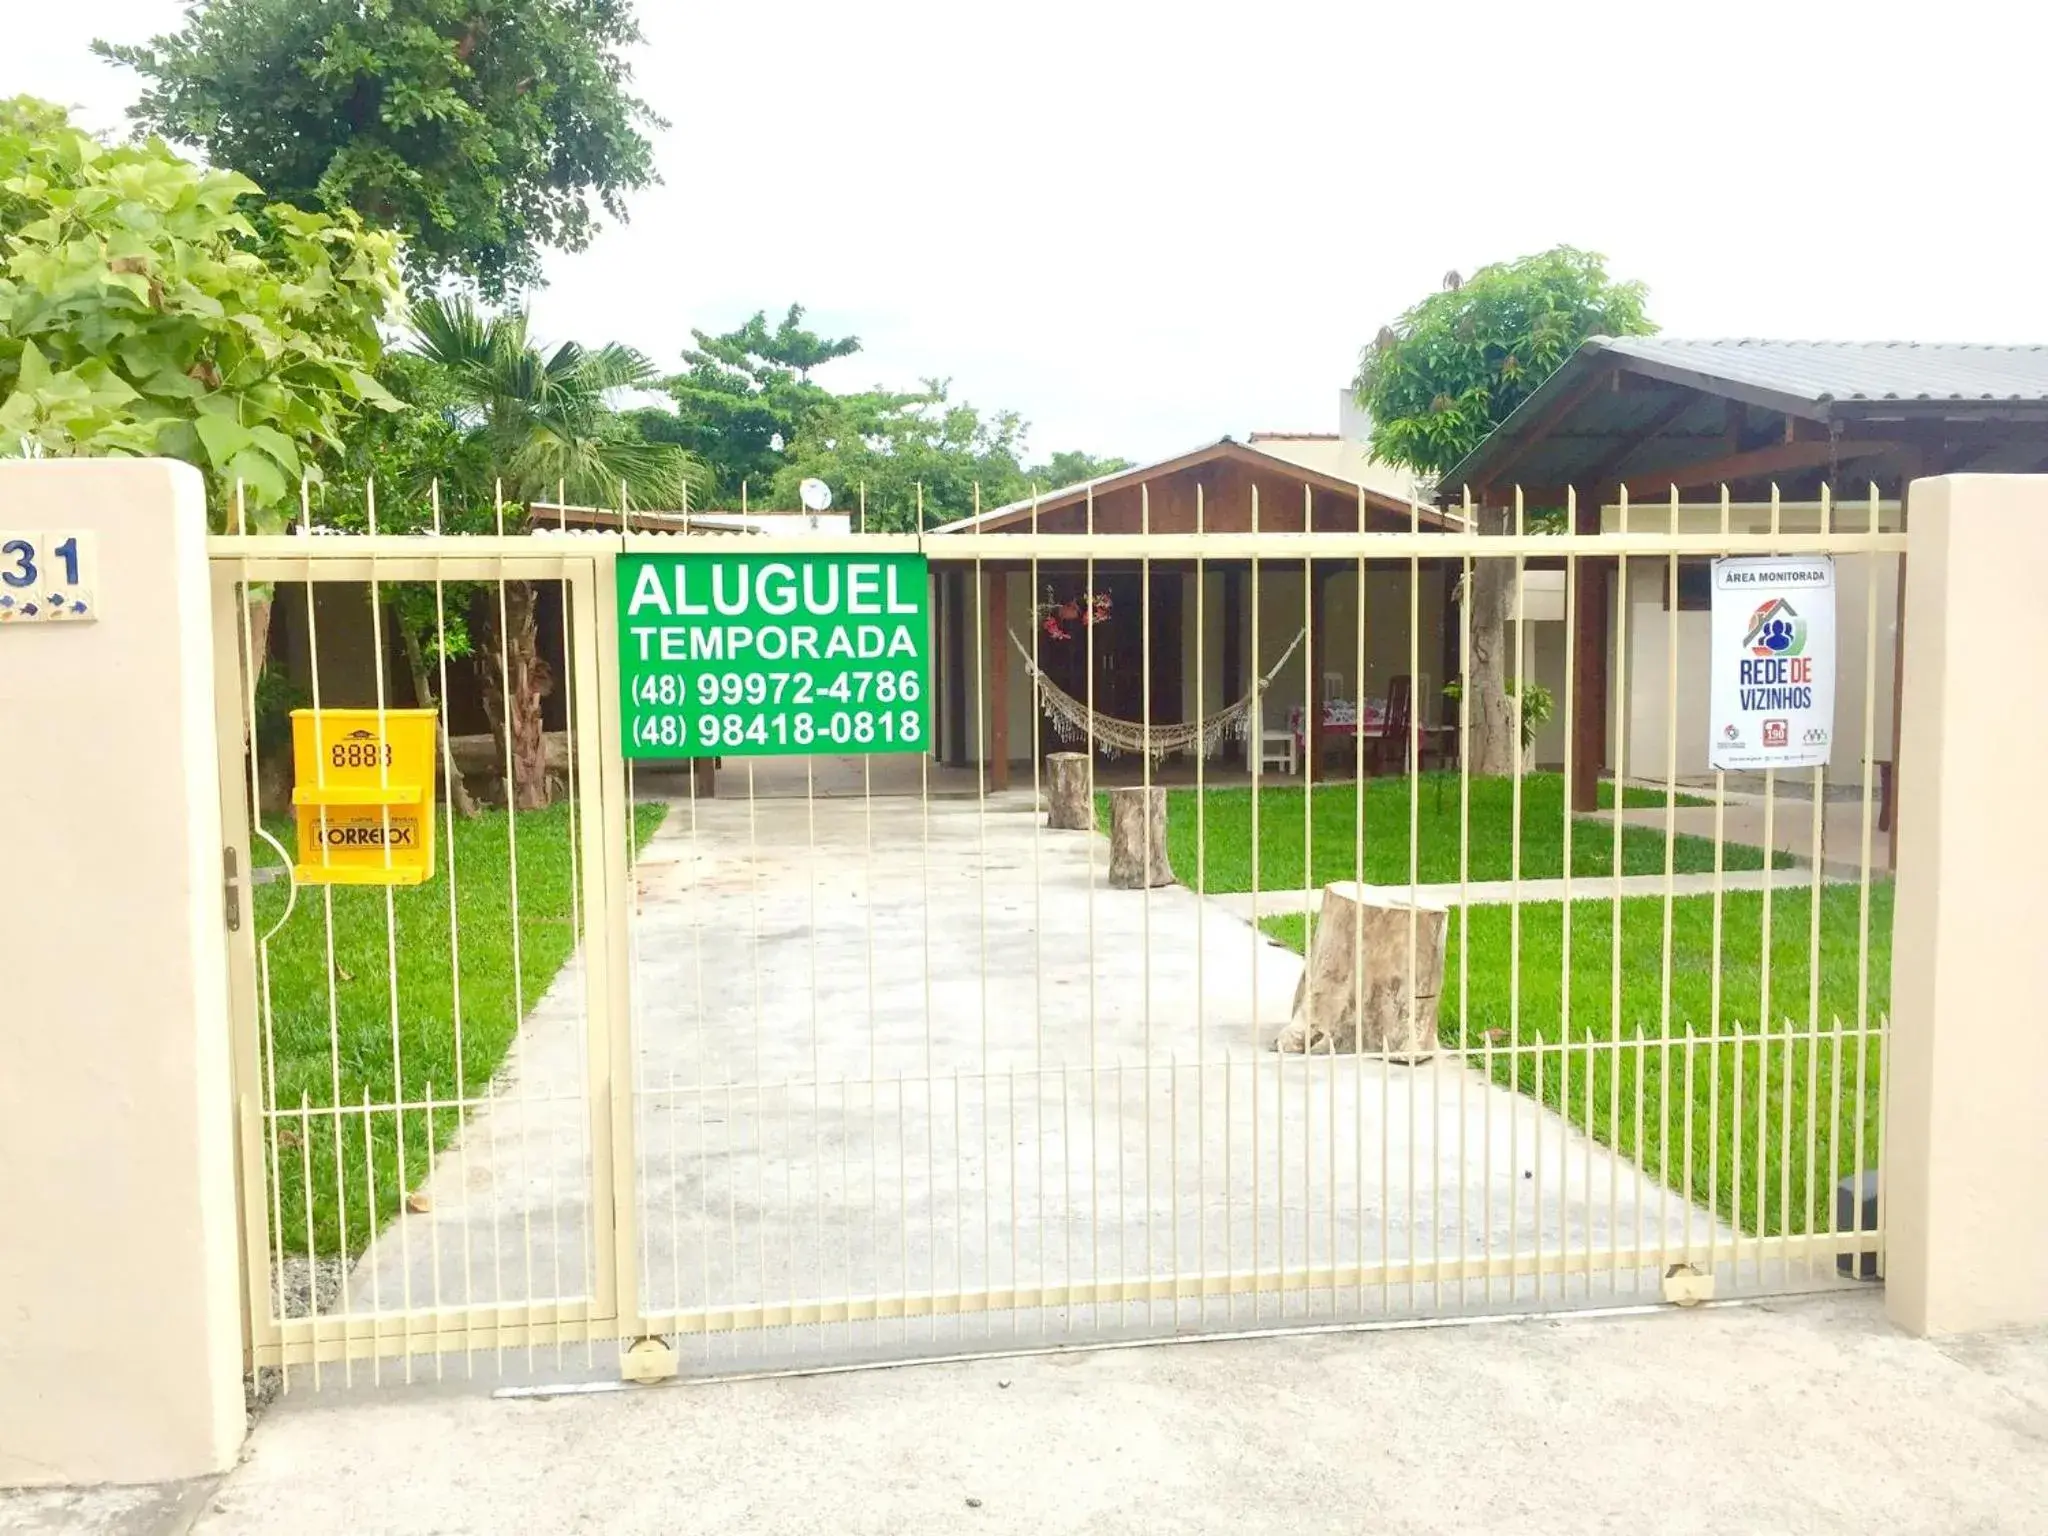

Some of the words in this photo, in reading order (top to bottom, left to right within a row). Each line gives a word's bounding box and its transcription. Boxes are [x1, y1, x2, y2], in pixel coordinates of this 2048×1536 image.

[2, 537, 79, 588] 31
[1725, 570, 1756, 583] ÁREA
[1758, 571, 1825, 582] MONITORADA
[627, 563, 918, 615] ALUGUEL
[630, 625, 918, 661] TEMPORADA
[631, 673, 686, 707] (48)
[697, 670, 921, 706] 99972-4786
[1740, 658, 1788, 685] REDE
[1791, 657, 1812, 684] DE
[1740, 687, 1812, 711] VIZINHOS
[632, 714, 687, 747] (48)
[698, 710, 921, 747] 98418-0818
